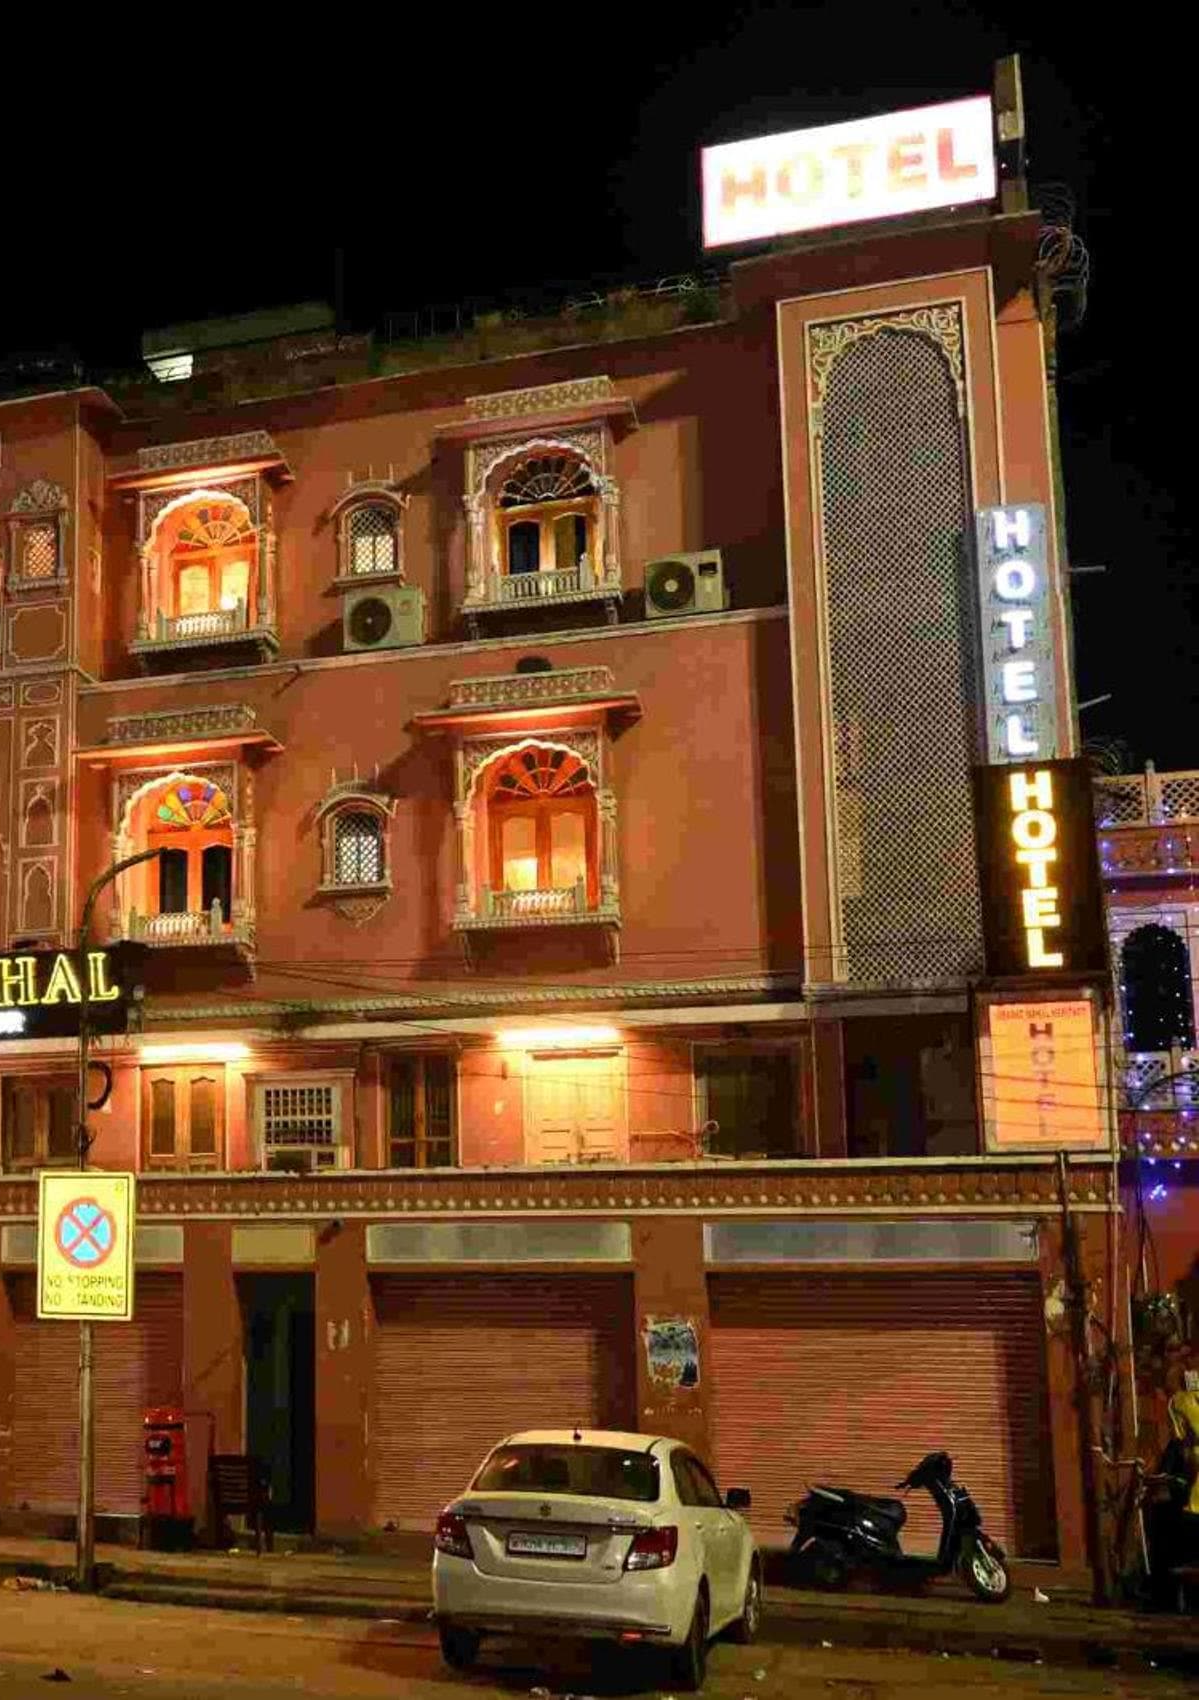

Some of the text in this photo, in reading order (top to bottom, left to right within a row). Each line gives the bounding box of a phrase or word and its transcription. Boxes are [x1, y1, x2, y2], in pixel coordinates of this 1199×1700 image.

[720, 128, 978, 215] HOTEL
[992, 510, 1040, 756] HOTEL
[1009, 770, 1064, 968] HOTEL
[45, 1291, 124, 1308] NO TANDING
[47, 1275, 62, 1289] NO
